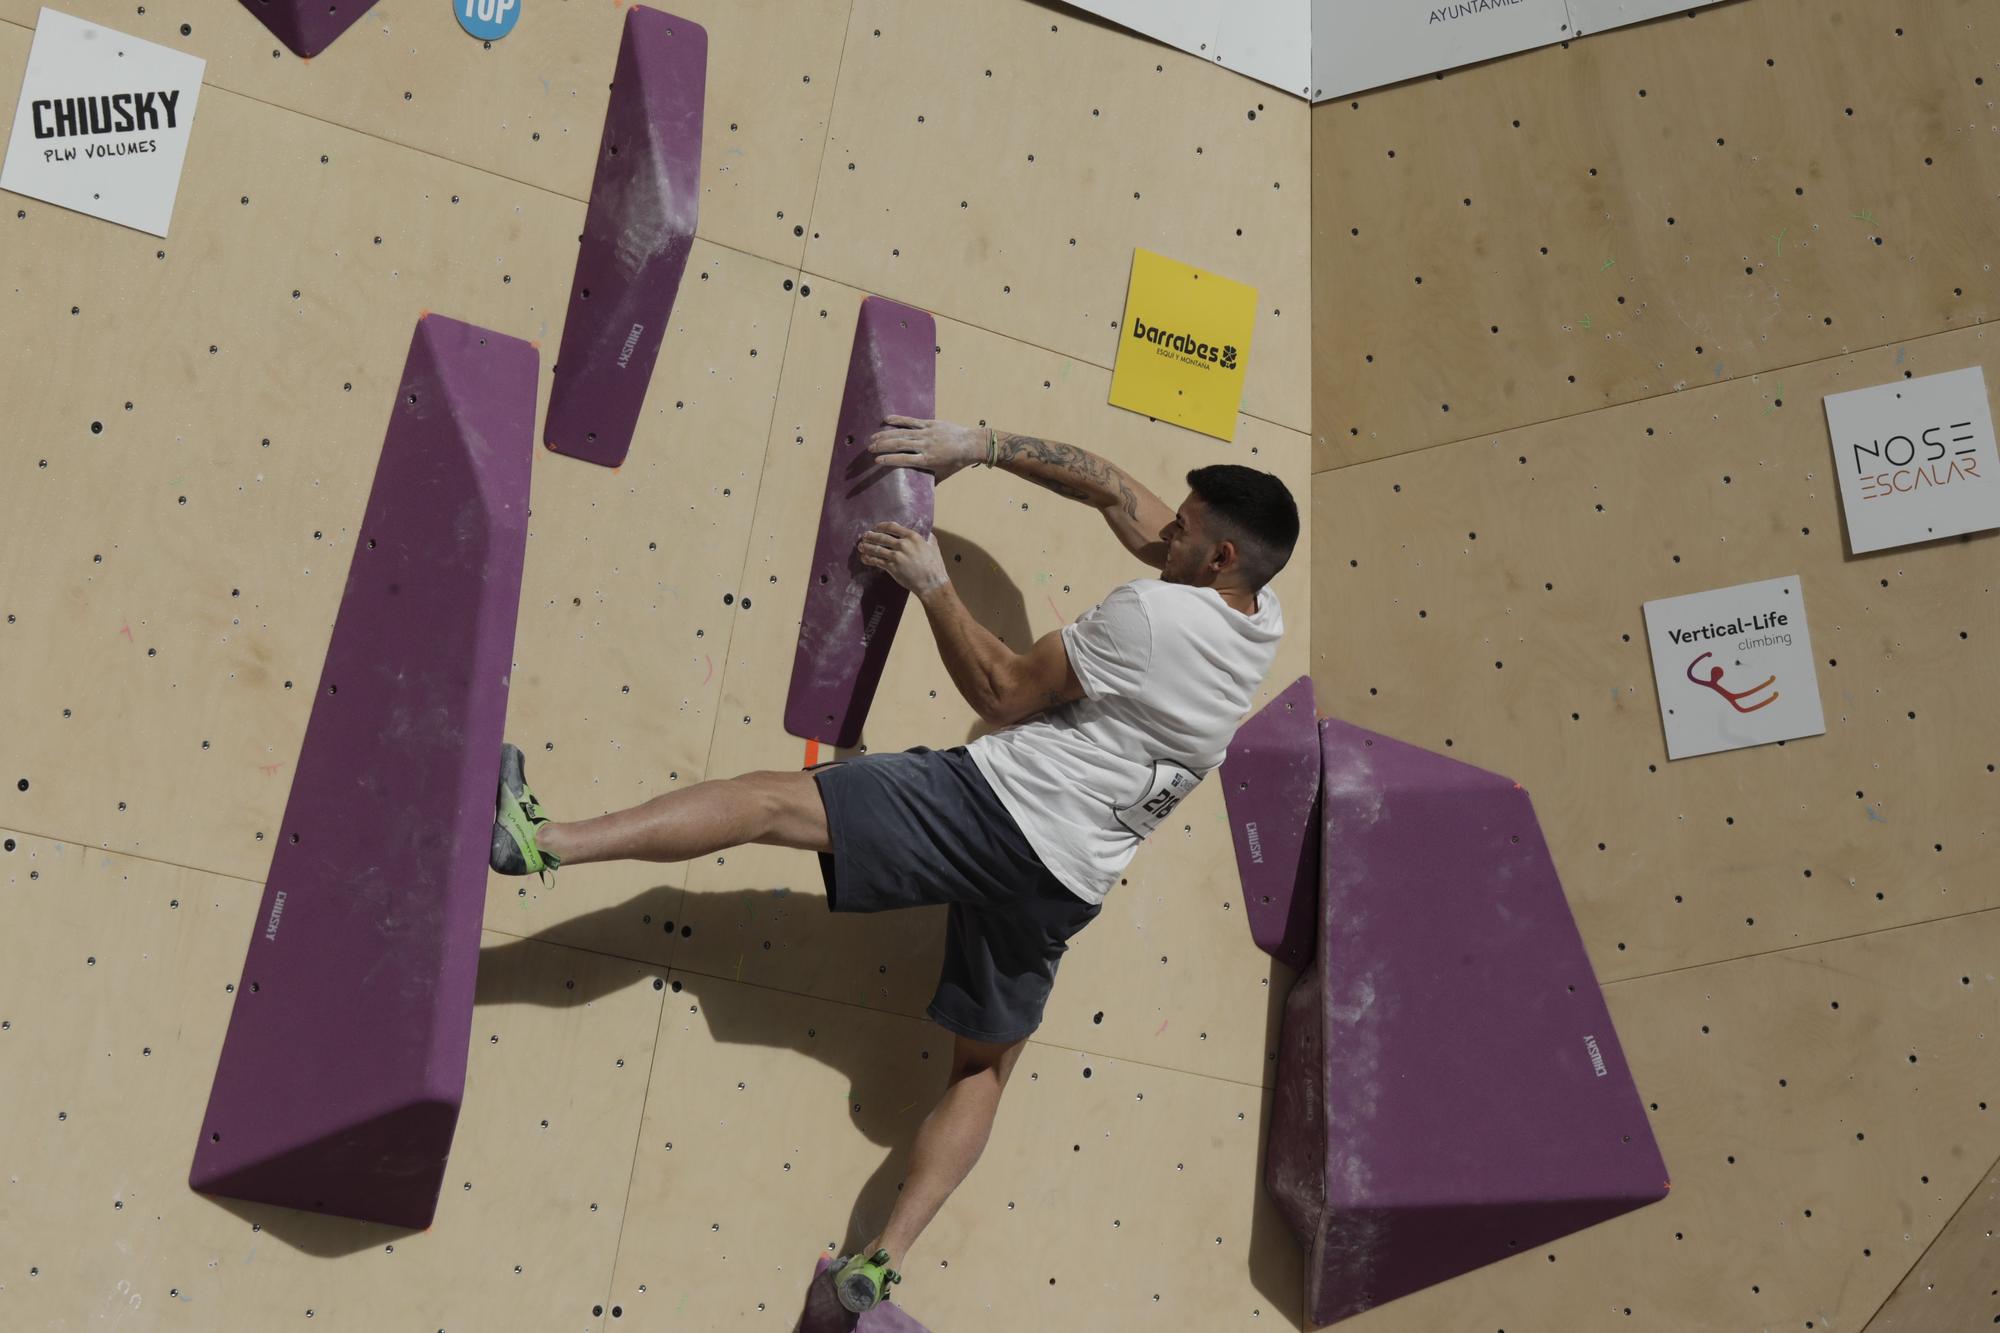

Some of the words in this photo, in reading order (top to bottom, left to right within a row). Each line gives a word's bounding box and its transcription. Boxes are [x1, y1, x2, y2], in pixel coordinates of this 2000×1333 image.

[32, 90, 180, 139] CHIUSKY
[44, 147, 77, 163] PLW
[85, 140, 157, 159] VOLUMES
[617, 323, 644, 369] CHIUSKY
[1133, 317, 1219, 363] barrabes
[1853, 421, 1977, 475] NOSE
[1860, 457, 1981, 500] ESCALAR
[1668, 611, 1788, 645] Vertical-Life
[1738, 633, 1792, 651] climbing
[1246, 822, 1264, 864] CHIUSKY
[265, 890, 287, 941] CHIUSKY
[1583, 1035, 1607, 1077] CHIUSKY
